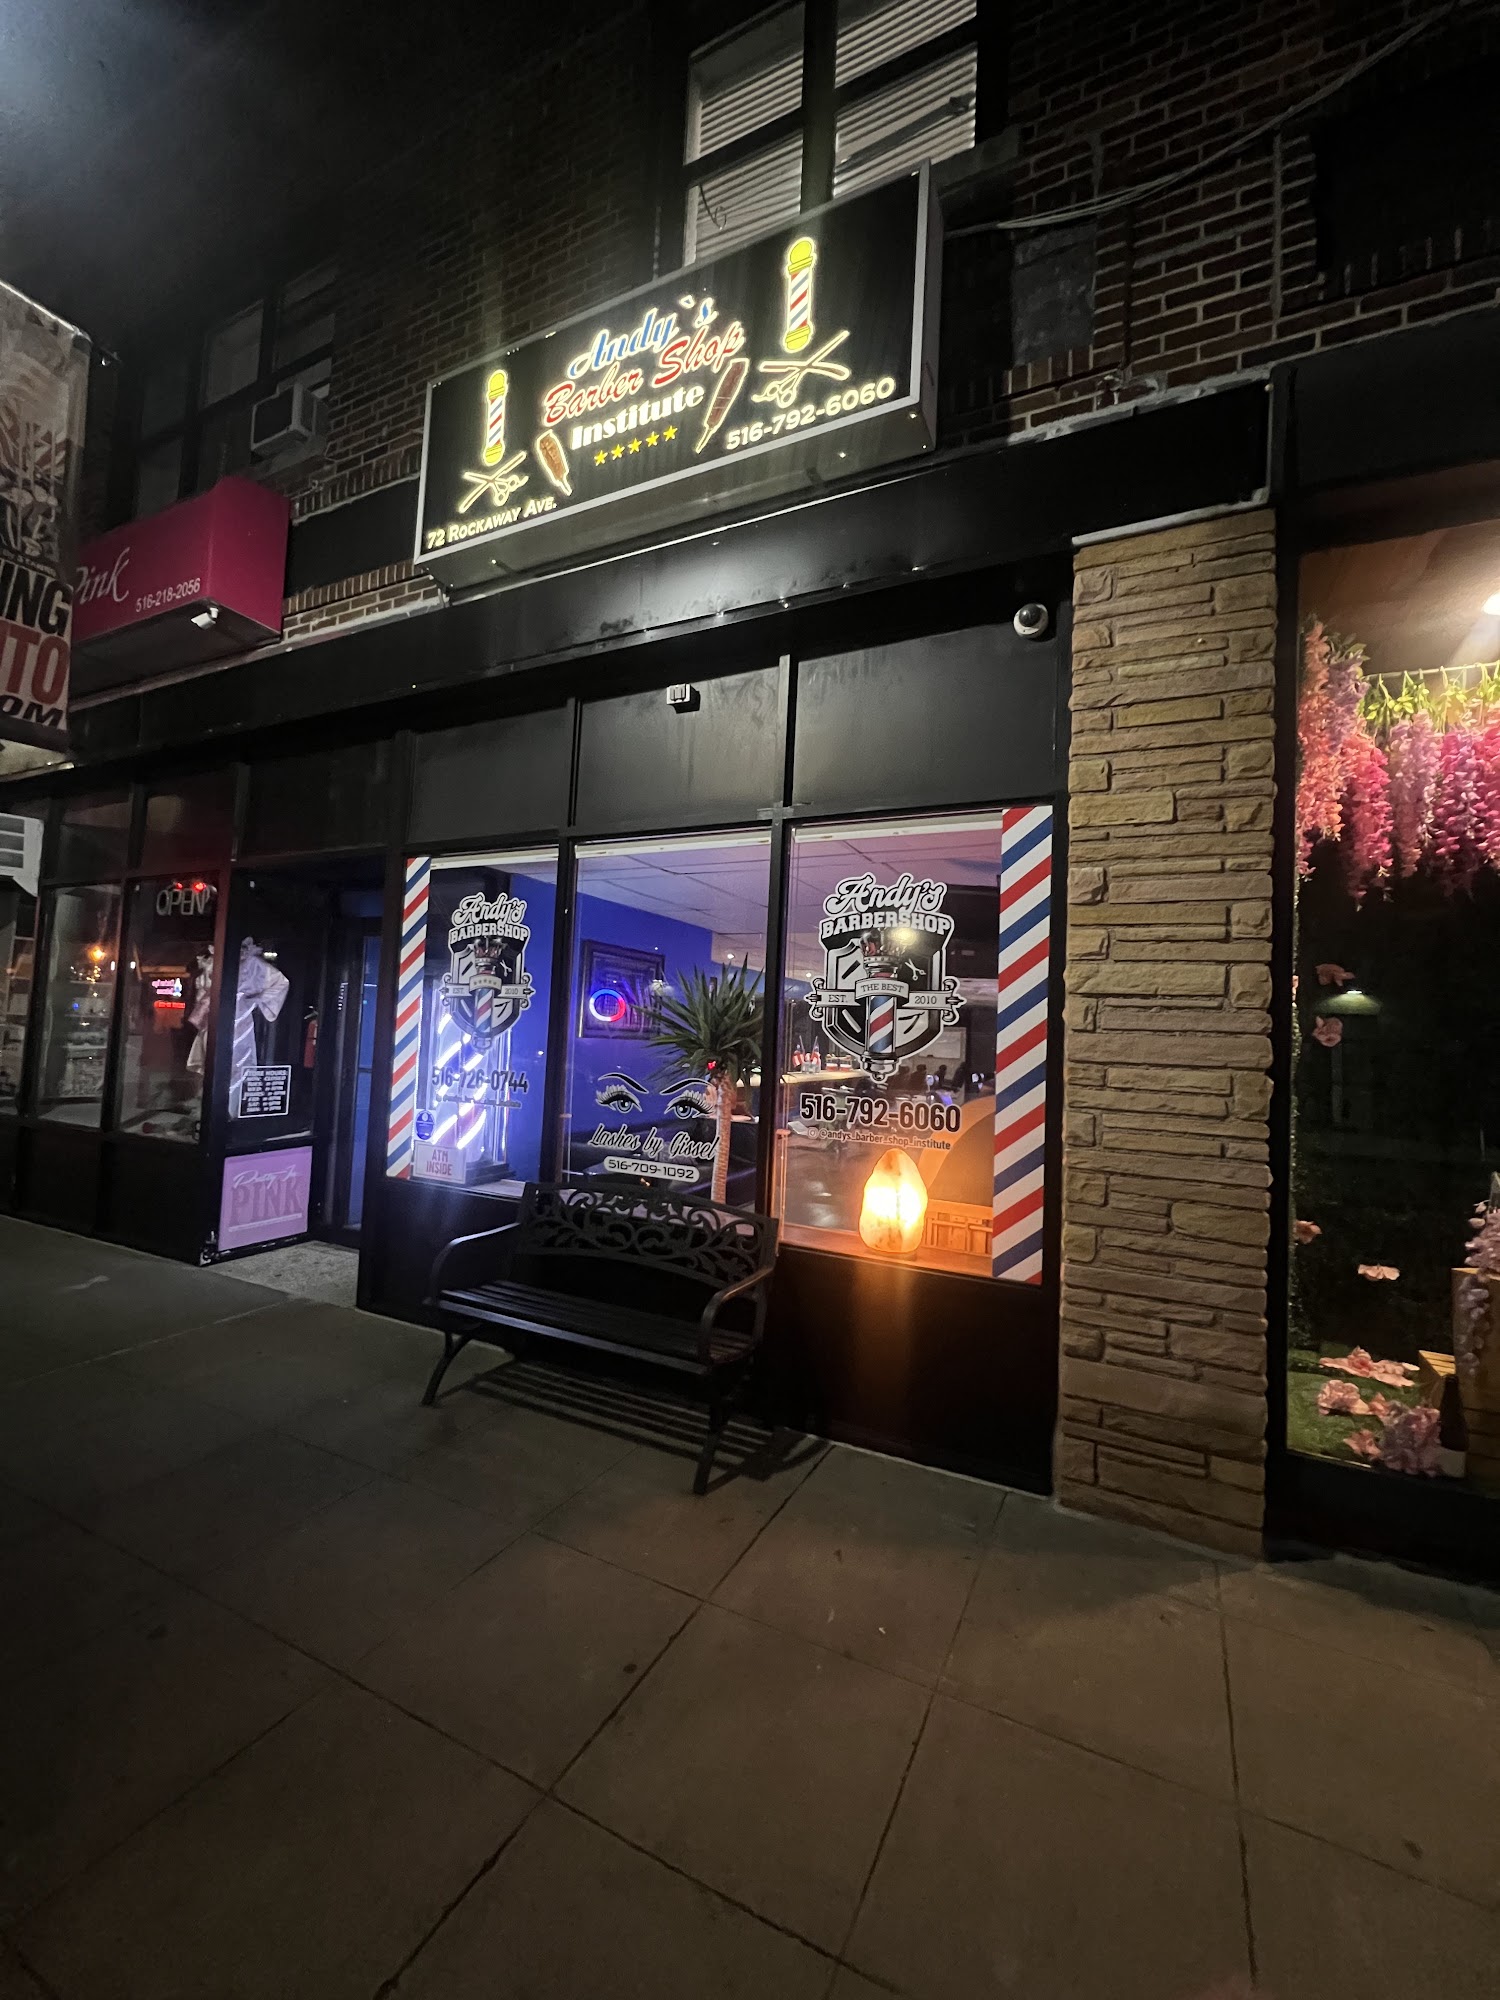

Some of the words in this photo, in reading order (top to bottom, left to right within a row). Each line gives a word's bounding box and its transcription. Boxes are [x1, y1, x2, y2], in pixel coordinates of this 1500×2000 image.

[543, 361, 645, 427] Barber
[651, 321, 746, 389] Shop
[571, 385, 705, 450] Institute
[726, 376, 896, 450] 516-792-6060
[427, 528, 446, 550] 72
[136, 577, 201, 613] 516-218-2056
[452, 892, 526, 925] Andy's
[826, 874, 946, 915] Andy's
[450, 922, 530, 944] BARBERSHOP
[821, 911, 953, 939] BARBERSHOP
[828, 994, 848, 1003] EST.
[914, 995, 938, 1005] 2010
[861, 983, 879, 993] THE
[880, 983, 905, 993] BEST
[800, 1094, 962, 1134] 516-792-6060
[586, 1122, 642, 1152] Lashes
[642, 1126, 664, 1159] by
[820, 1128, 952, 1151] @andys_barber_shop_institute
[425, 1160, 453, 1177] INSIDE
[431, 1148, 449, 1163] ATM
[608, 1159, 695, 1180] 516-709-1092
[228, 1174, 304, 1228] PINK
